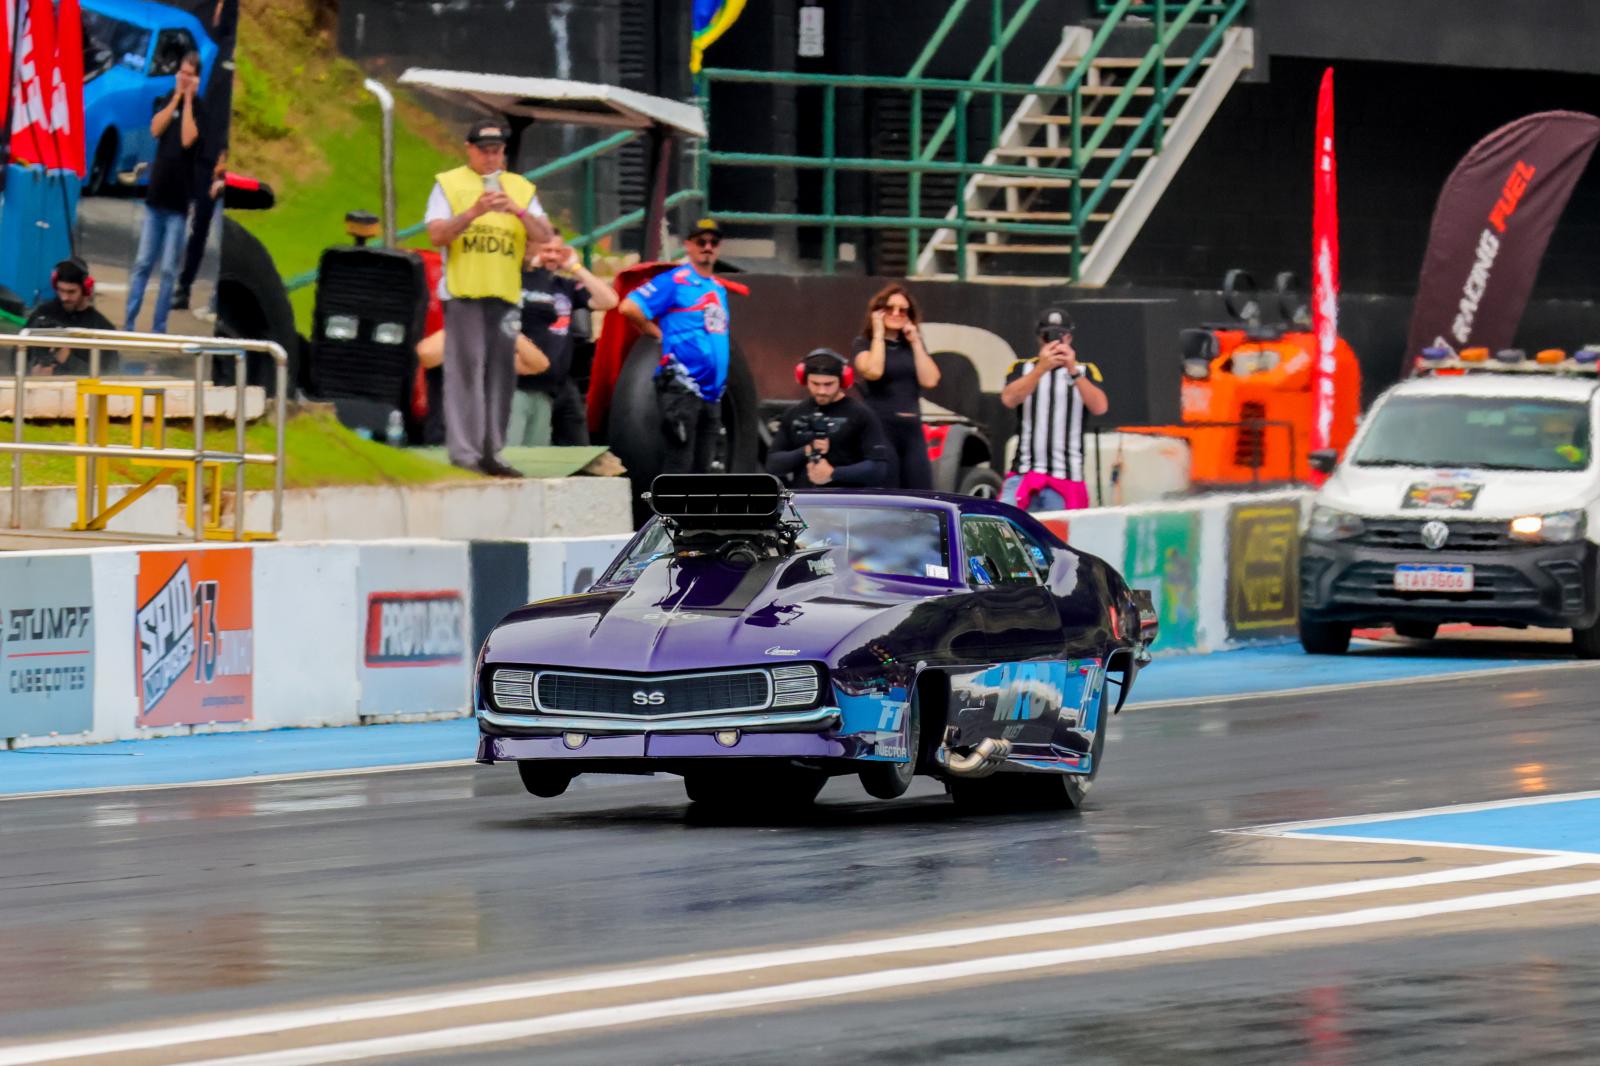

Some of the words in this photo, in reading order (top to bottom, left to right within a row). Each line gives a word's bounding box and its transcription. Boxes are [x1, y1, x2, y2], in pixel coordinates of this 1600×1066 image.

[1452, 228, 1499, 343] RACING
[1488, 160, 1537, 233] FUEL
[632, 691, 666, 705] SS
[874, 742, 907, 758] INJECTOR
